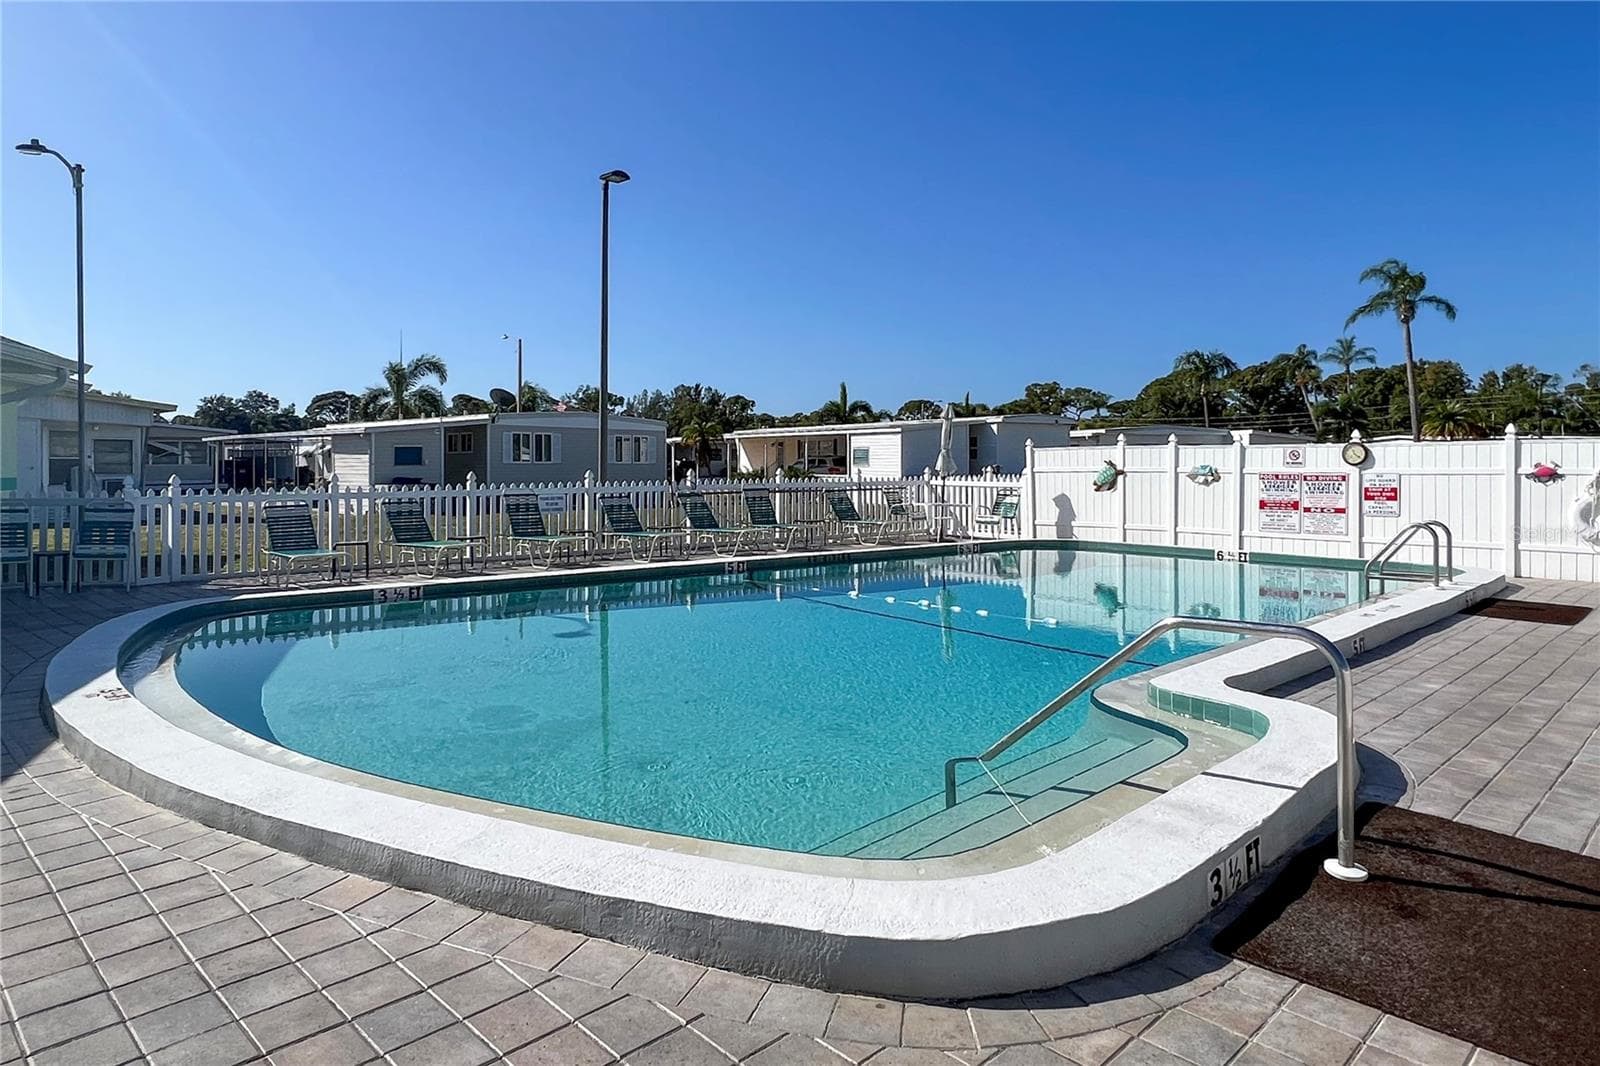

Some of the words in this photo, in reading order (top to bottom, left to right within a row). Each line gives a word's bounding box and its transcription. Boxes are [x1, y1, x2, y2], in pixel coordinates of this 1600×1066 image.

[1217, 550, 1224, 561] 6
[378, 588, 388, 603] 3
[408, 586, 421, 601] FT
[1209, 867, 1223, 908] 3
[1245, 836, 1260, 880] FT
